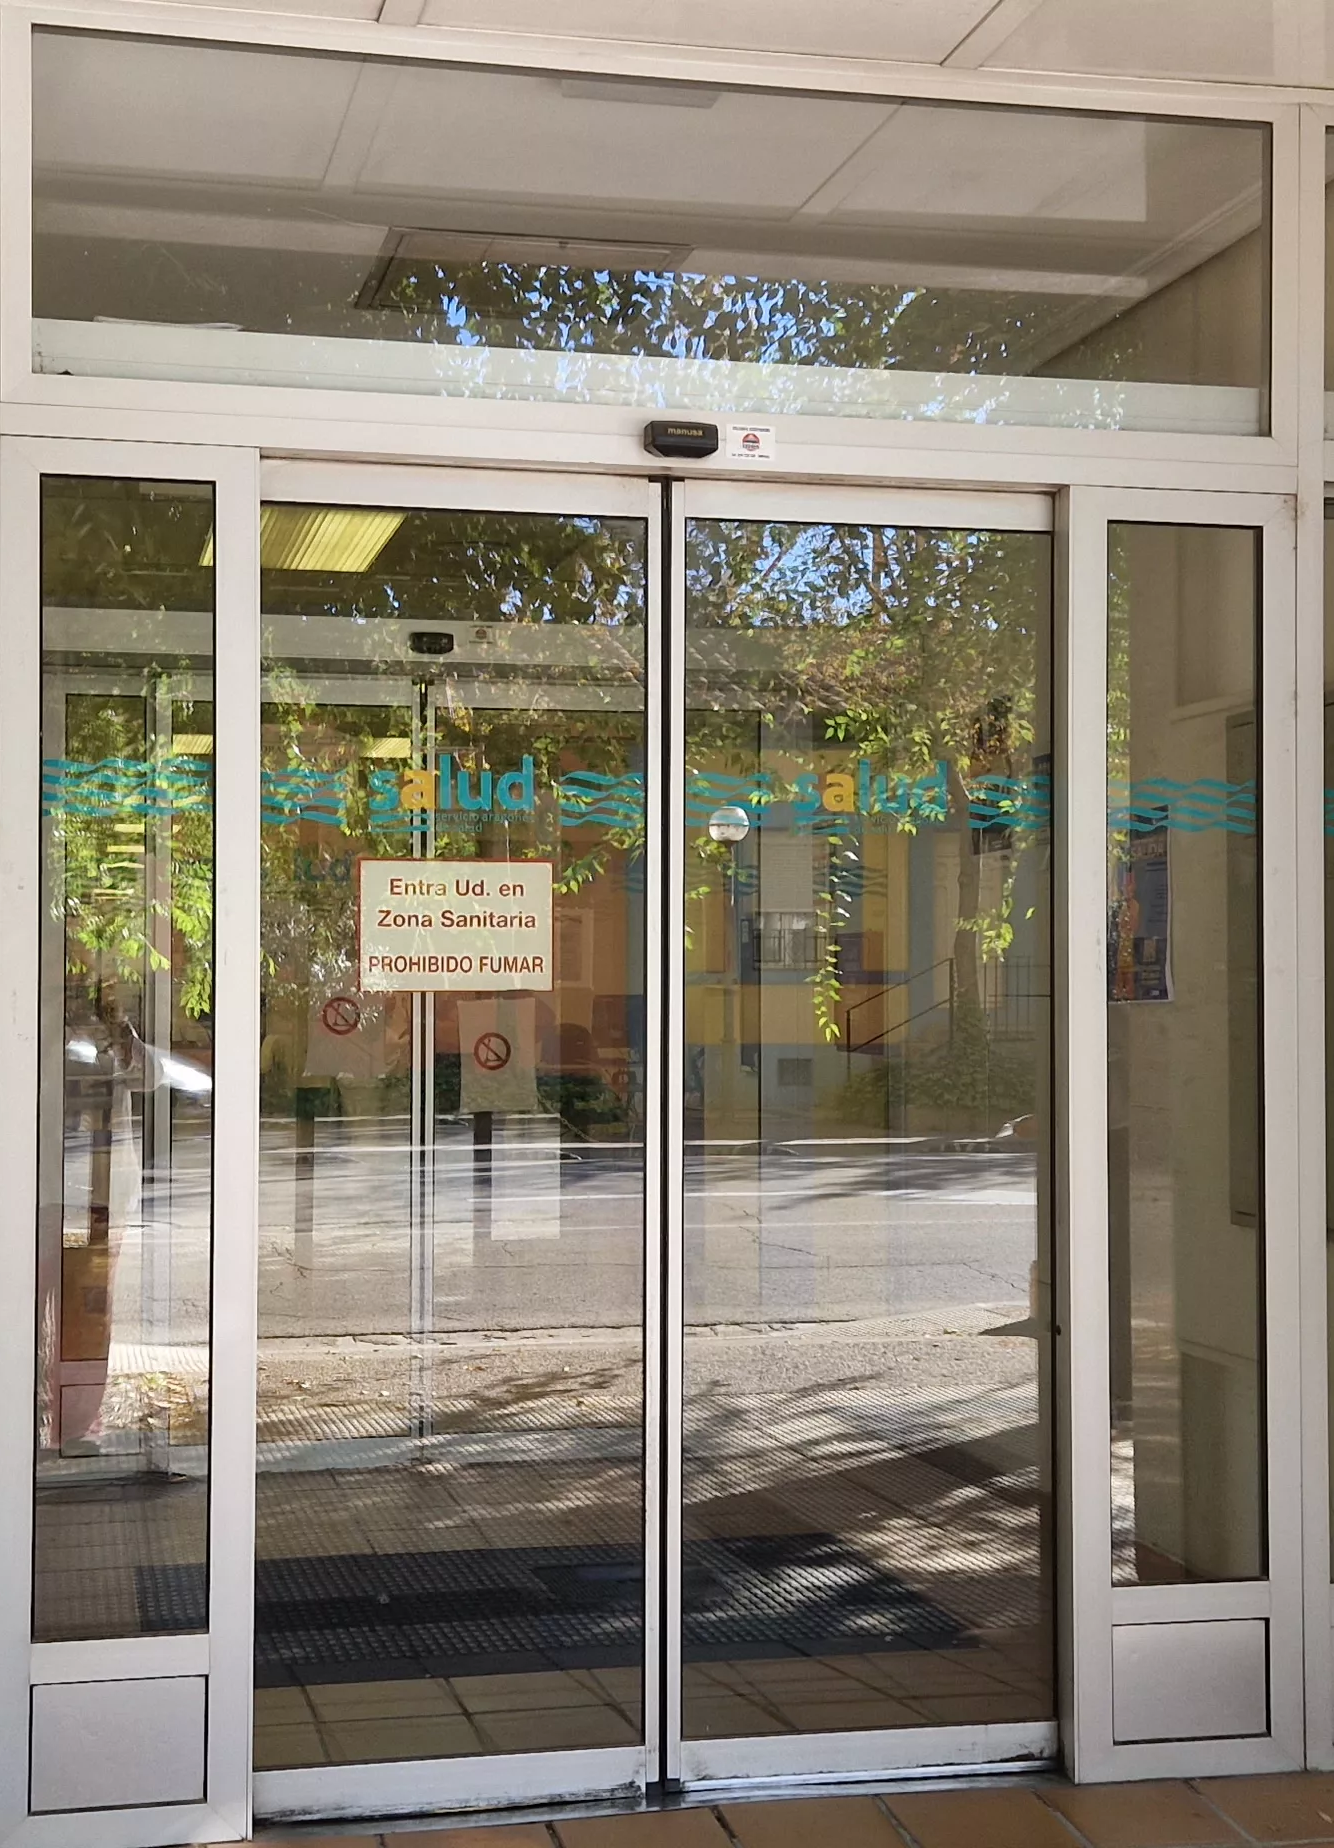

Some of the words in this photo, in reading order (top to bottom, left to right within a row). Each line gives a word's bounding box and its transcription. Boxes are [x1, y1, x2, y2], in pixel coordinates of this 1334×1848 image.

[667, 427, 703, 437] manusa
[368, 754, 535, 811] salud
[795, 759, 949, 813] salud
[389, 878, 447, 896] Entra
[455, 879, 491, 897] Ud.
[498, 883, 525, 897] en
[377, 909, 433, 928] Zona
[440, 909, 536, 928] Sanitaria
[368, 955, 473, 973] PROHIBIDO
[479, 956, 544, 973] FUMAR
